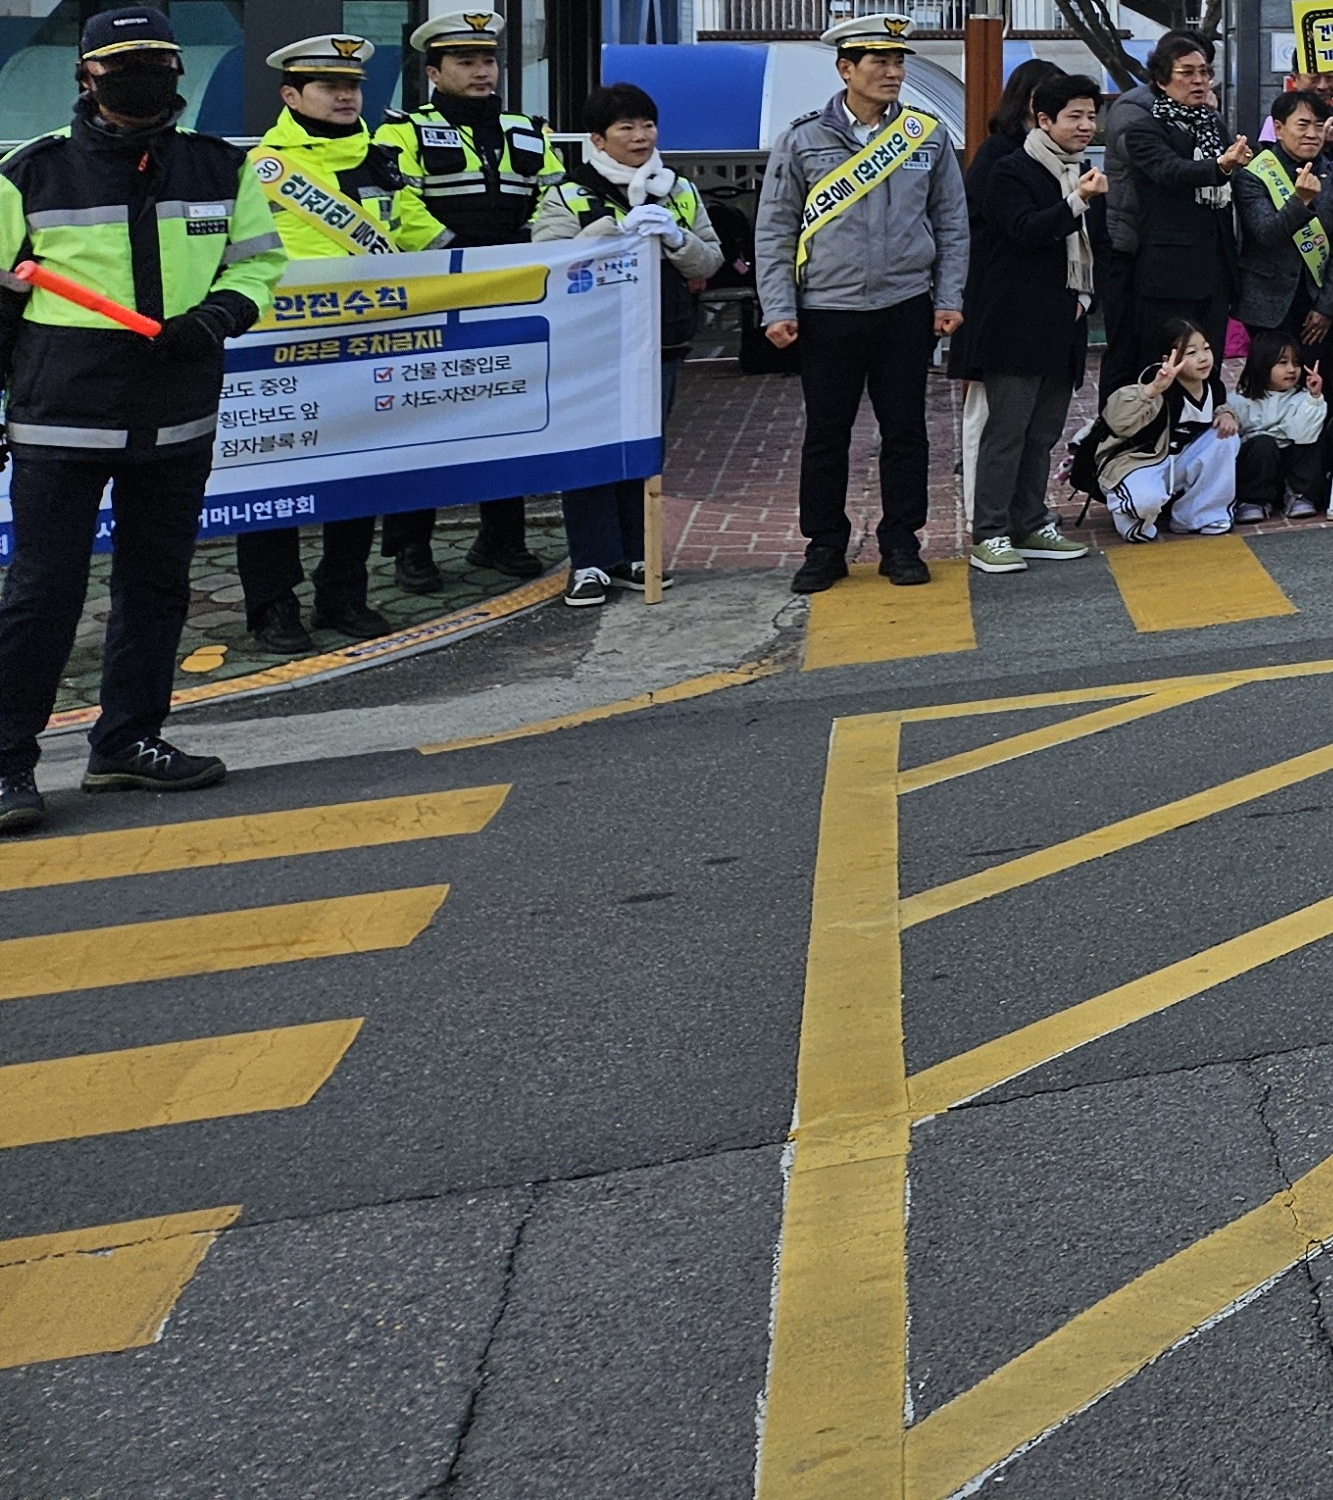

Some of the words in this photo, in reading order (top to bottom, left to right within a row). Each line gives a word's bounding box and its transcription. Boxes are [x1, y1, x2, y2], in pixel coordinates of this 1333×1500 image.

[906, 119, 920, 135] 30
[852, 132, 909, 185] 안전한
[257, 160, 279, 179] 30
[280, 173, 356, 230] 안전한
[800, 177, 856, 230] 등하교
[272, 285, 409, 323] 안전수칙
[273, 339, 342, 365] 이곳은
[345, 328, 444, 357] 주차금지!
[400, 361, 439, 383] 건물
[441, 353, 513, 380] 진출입로
[259, 375, 299, 397] 중앙
[218, 404, 297, 429] 횡단보도
[299, 400, 320, 421] 앞
[219, 432, 295, 458] 점자블록
[299, 428, 319, 447] 위
